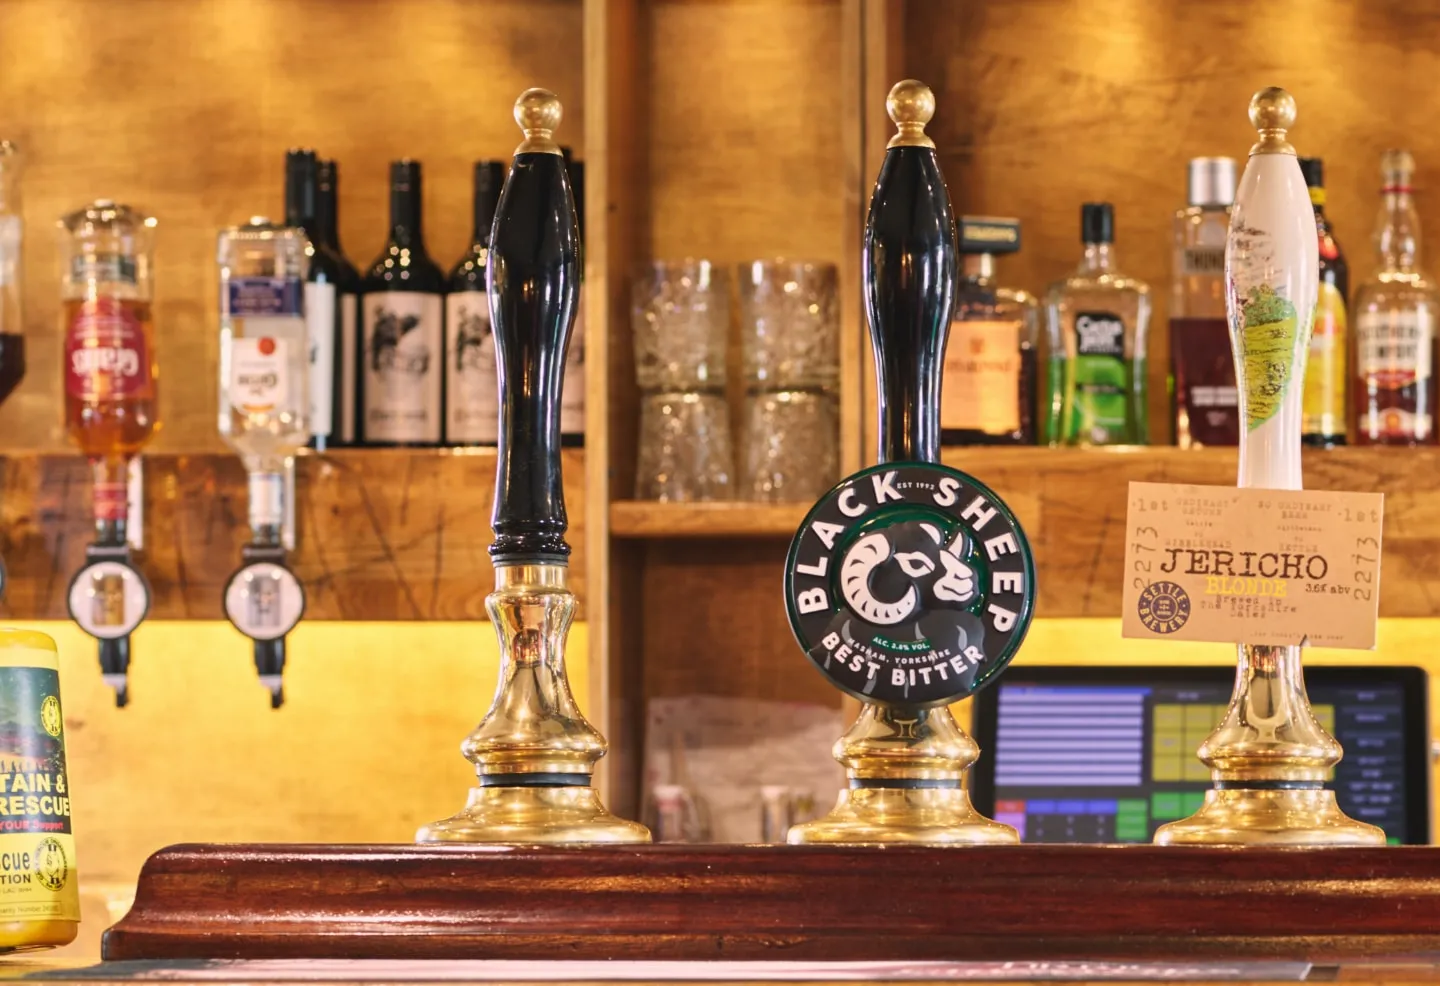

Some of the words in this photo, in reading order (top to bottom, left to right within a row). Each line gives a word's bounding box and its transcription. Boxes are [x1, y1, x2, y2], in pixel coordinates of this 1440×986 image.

[916, 482, 935, 490] 1992
[797, 471, 903, 614] BLACK
[933, 477, 1023, 632] SHEEP
[1160, 548, 1328, 580] JERICHO
[1352, 537, 1379, 601] 2273
[1143, 583, 1187, 603] SETTLE
[1205, 576, 1287, 597] BLONDE
[1330, 585, 1351, 594] abv
[1140, 608, 1188, 632] BREWERY
[822, 632, 880, 680] BEST
[891, 645, 984, 686] BITTER
[895, 648, 951, 664] YORKSHIRE
[56, 774, 66, 793] &
[0, 795, 70, 816] RESCUE
